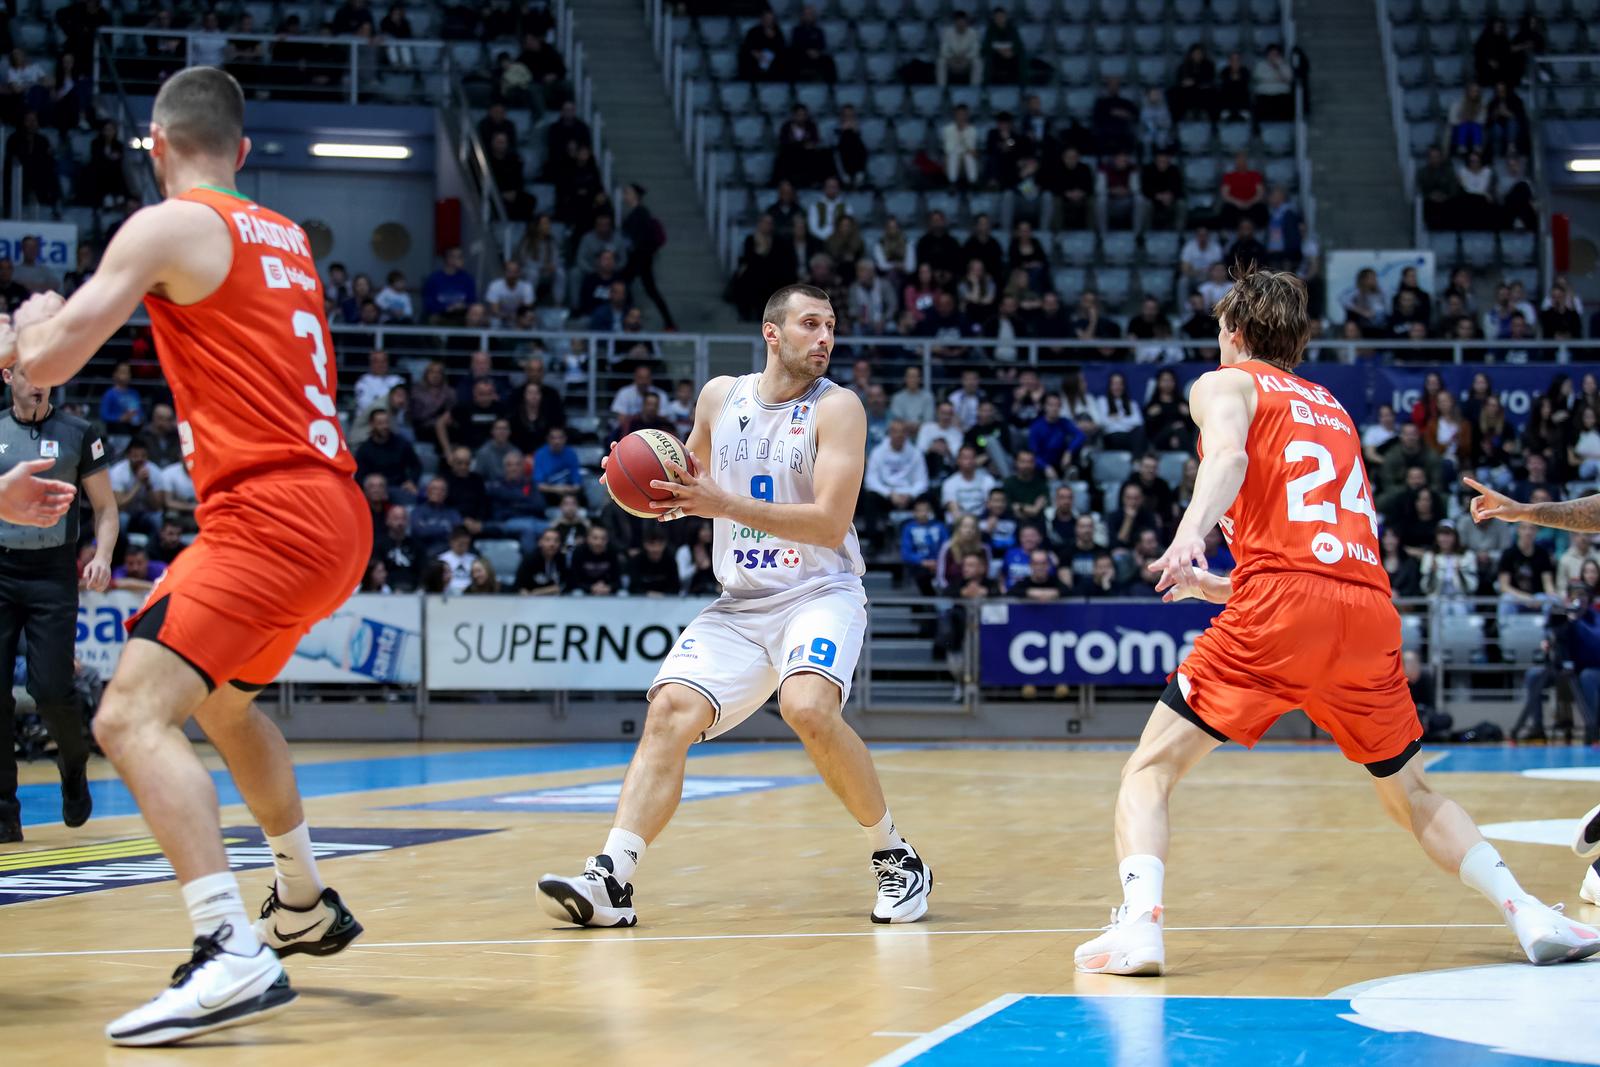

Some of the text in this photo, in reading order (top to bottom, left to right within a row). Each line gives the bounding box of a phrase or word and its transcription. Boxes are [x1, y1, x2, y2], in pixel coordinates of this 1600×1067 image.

[292, 310, 336, 417] 3
[720, 438, 803, 474] ZADAR
[750, 475, 774, 503] 9
[1285, 440, 1378, 540] 24
[733, 549, 780, 569] PSK
[1347, 542, 1378, 566] NLB
[453, 622, 690, 664] SUPERNO
[808, 637, 837, 668] 9
